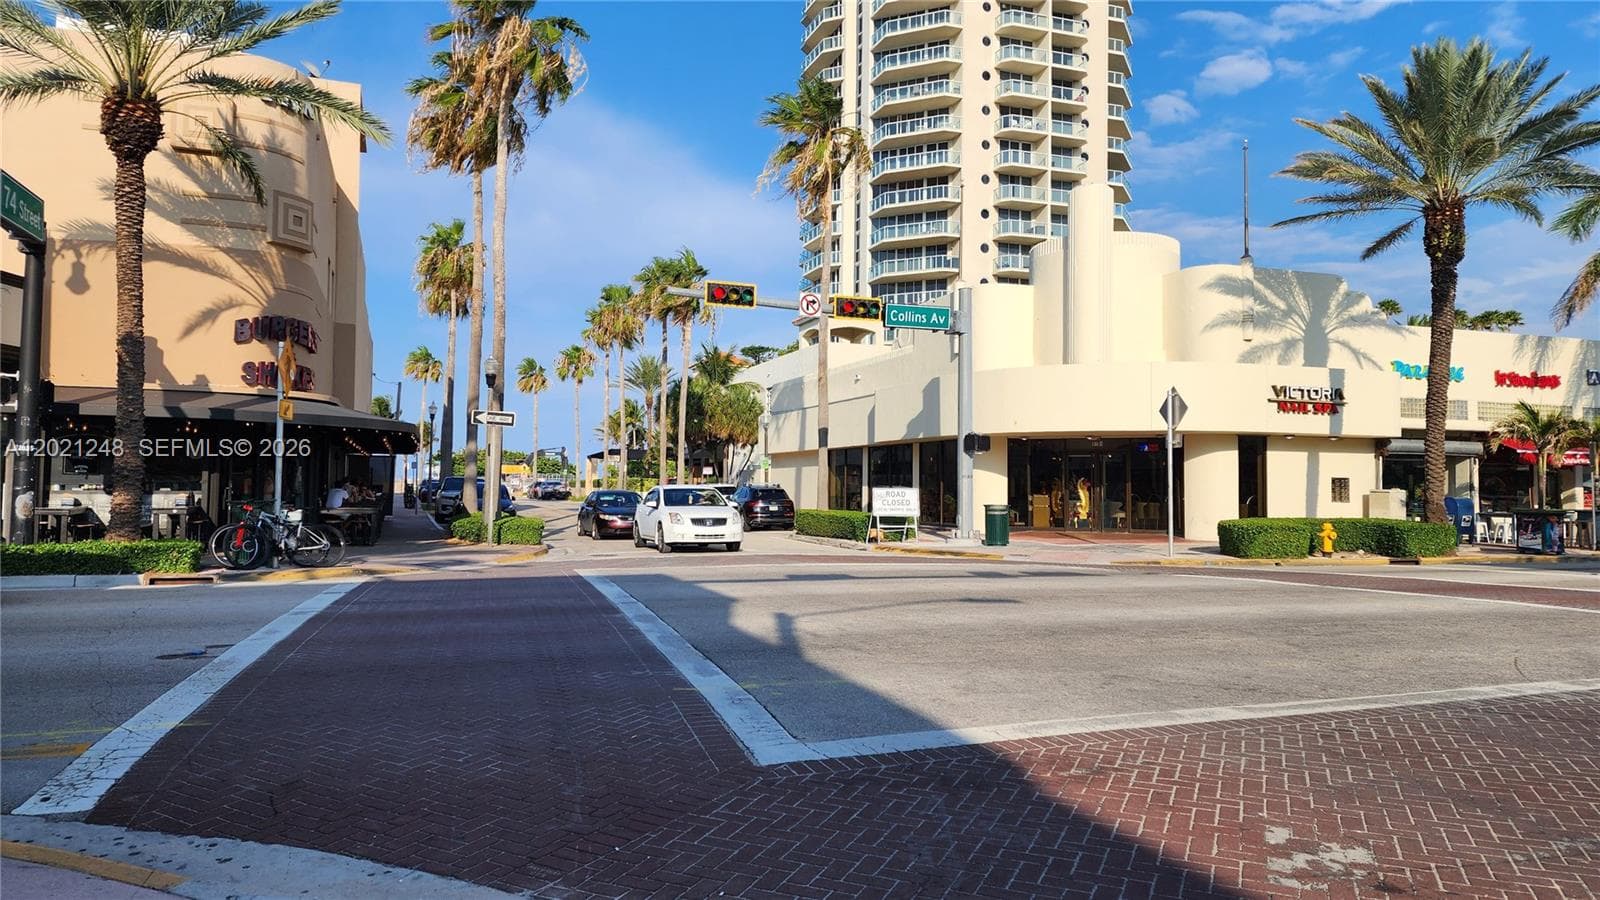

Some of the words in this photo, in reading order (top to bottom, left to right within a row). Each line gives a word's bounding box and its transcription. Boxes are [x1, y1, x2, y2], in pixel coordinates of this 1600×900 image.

[3, 185, 17, 215] 74
[19, 200, 42, 231] Street
[890, 309, 927, 323] Collins
[930, 312, 946, 324] Av
[1270, 384, 1346, 401] VICTORIA
[885, 490, 906, 498] ROAD
